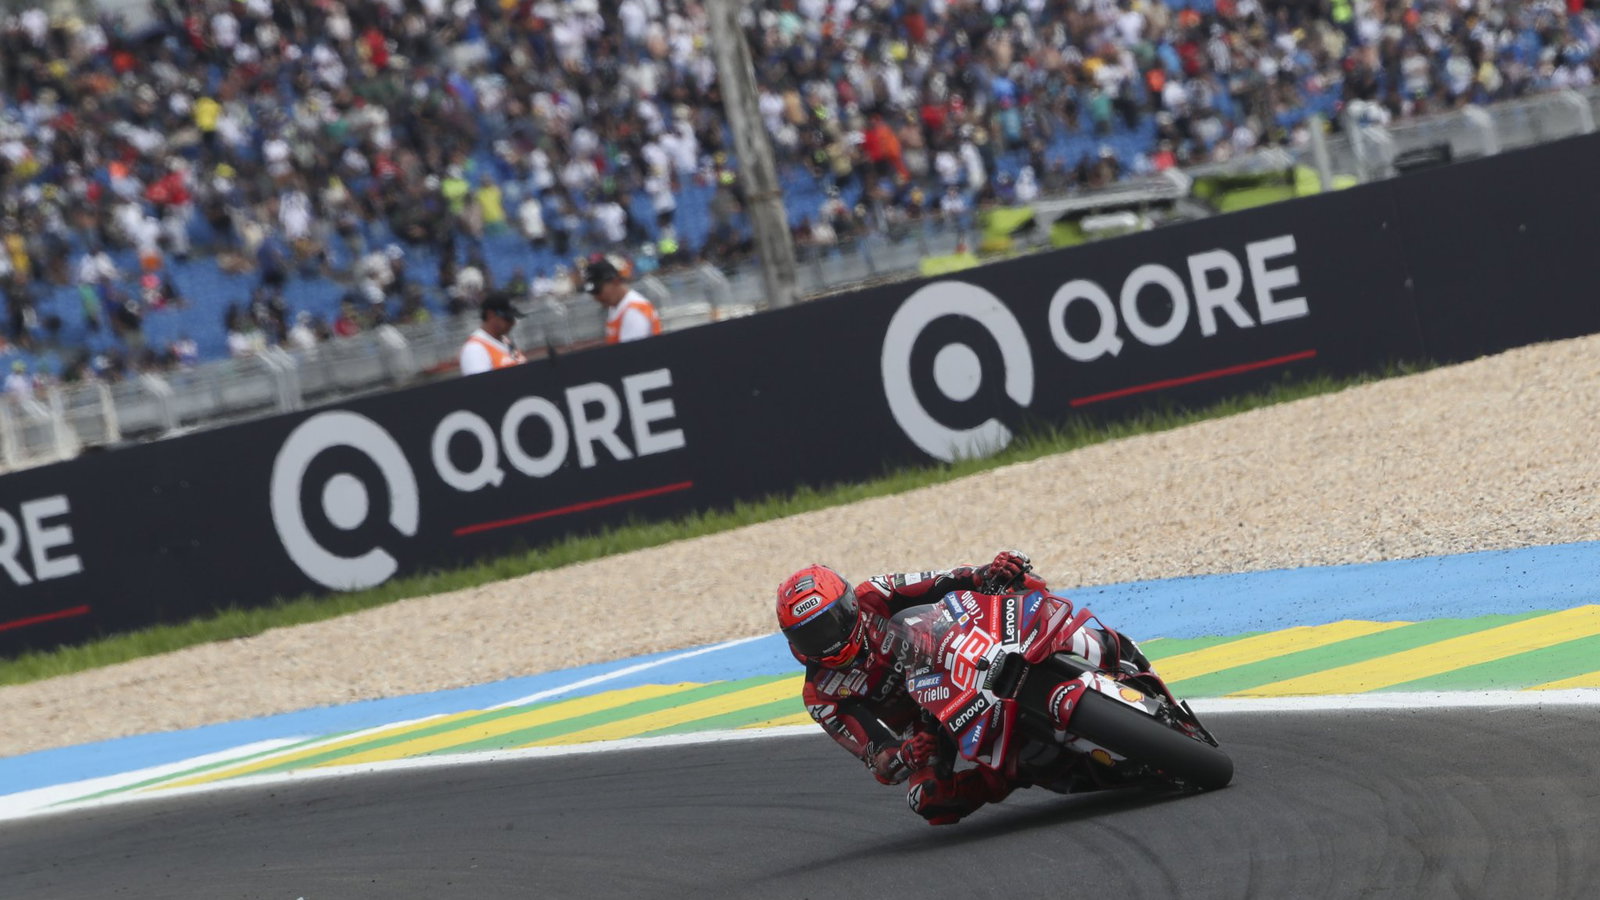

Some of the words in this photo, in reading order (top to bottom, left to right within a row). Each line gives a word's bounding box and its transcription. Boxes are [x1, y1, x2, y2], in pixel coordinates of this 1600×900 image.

[1049, 235, 1310, 363] QORE
[431, 368, 687, 493] QORE
[795, 597, 819, 615] SHOEI
[961, 591, 981, 618] riello
[1004, 598, 1015, 643] Lenovo
[1029, 596, 1043, 613] TIM
[871, 640, 909, 702] Lenovo
[951, 626, 994, 691] 93
[923, 686, 950, 703] riello
[1053, 684, 1076, 723] Lenovo
[949, 698, 985, 732] Lenovo
[971, 725, 982, 743] TIM
